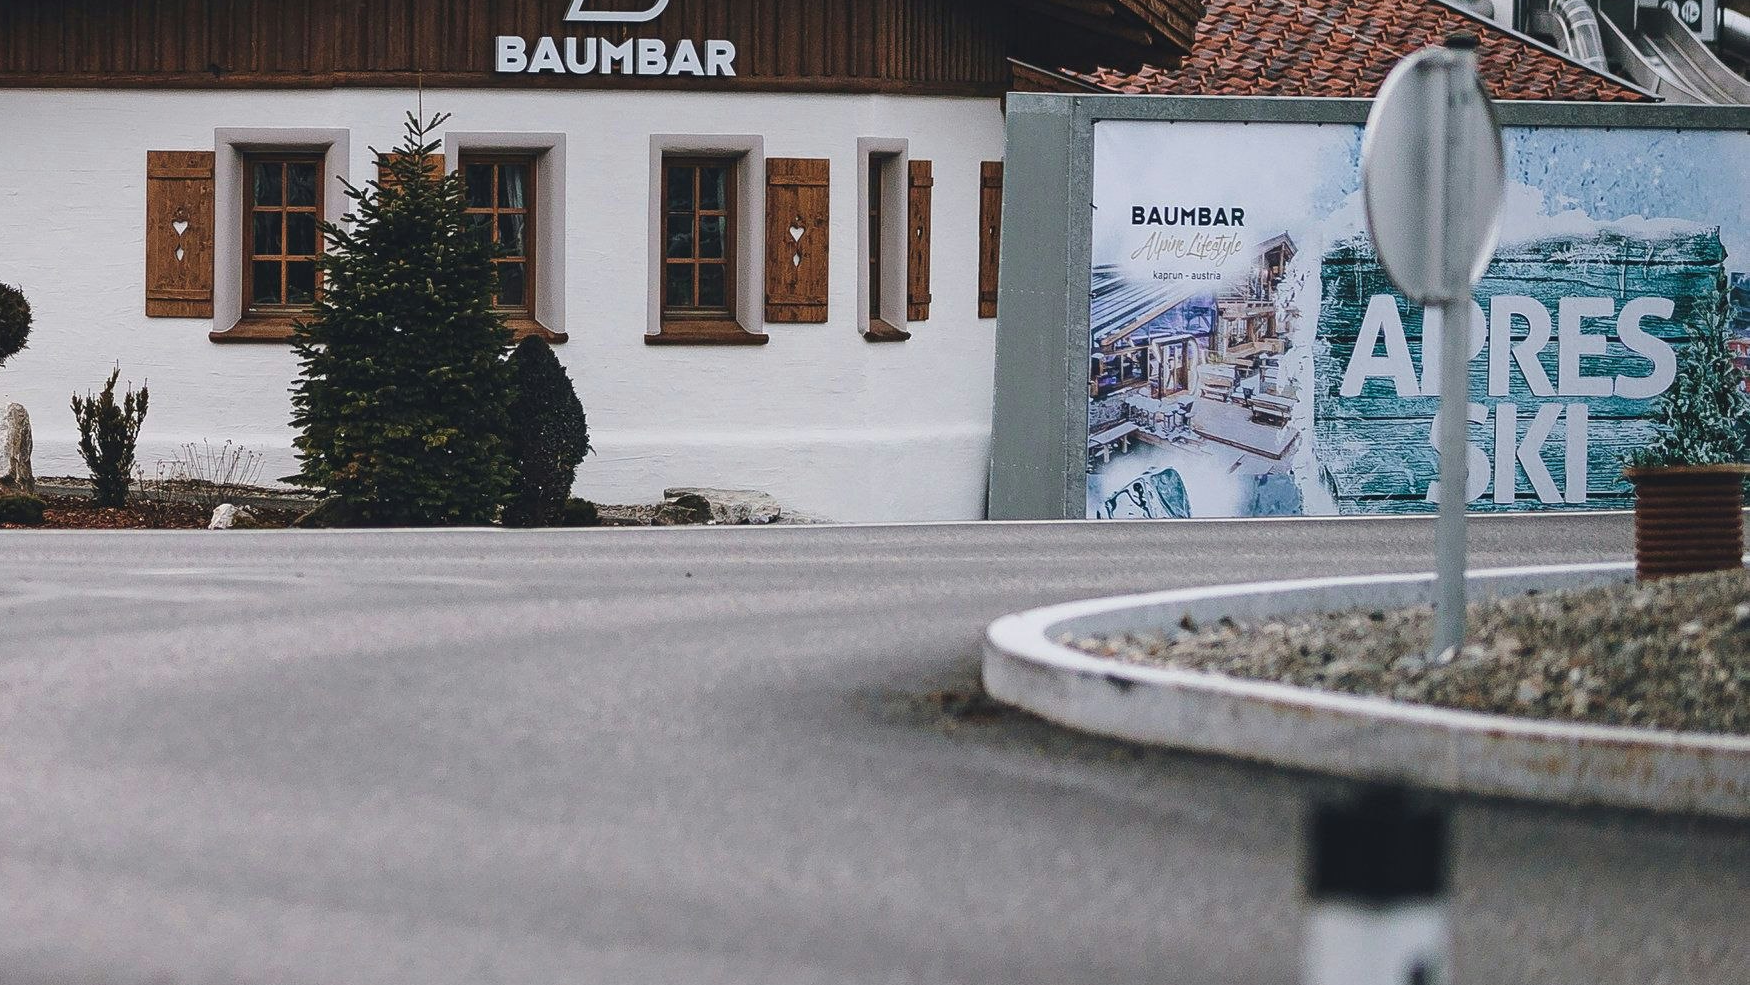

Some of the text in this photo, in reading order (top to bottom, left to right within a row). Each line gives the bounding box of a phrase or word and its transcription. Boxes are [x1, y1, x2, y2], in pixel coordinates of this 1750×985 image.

[495, 35, 737, 77] BAUMBAR
[1131, 206, 1245, 226] BAUMBAR
[1131, 231, 1242, 267] Alpine Lifestyle
[1153, 271, 1183, 281] kaprun
[1191, 271, 1221, 280] austria
[1339, 294, 1677, 399] APRES
[1425, 403, 1589, 504] SKI
